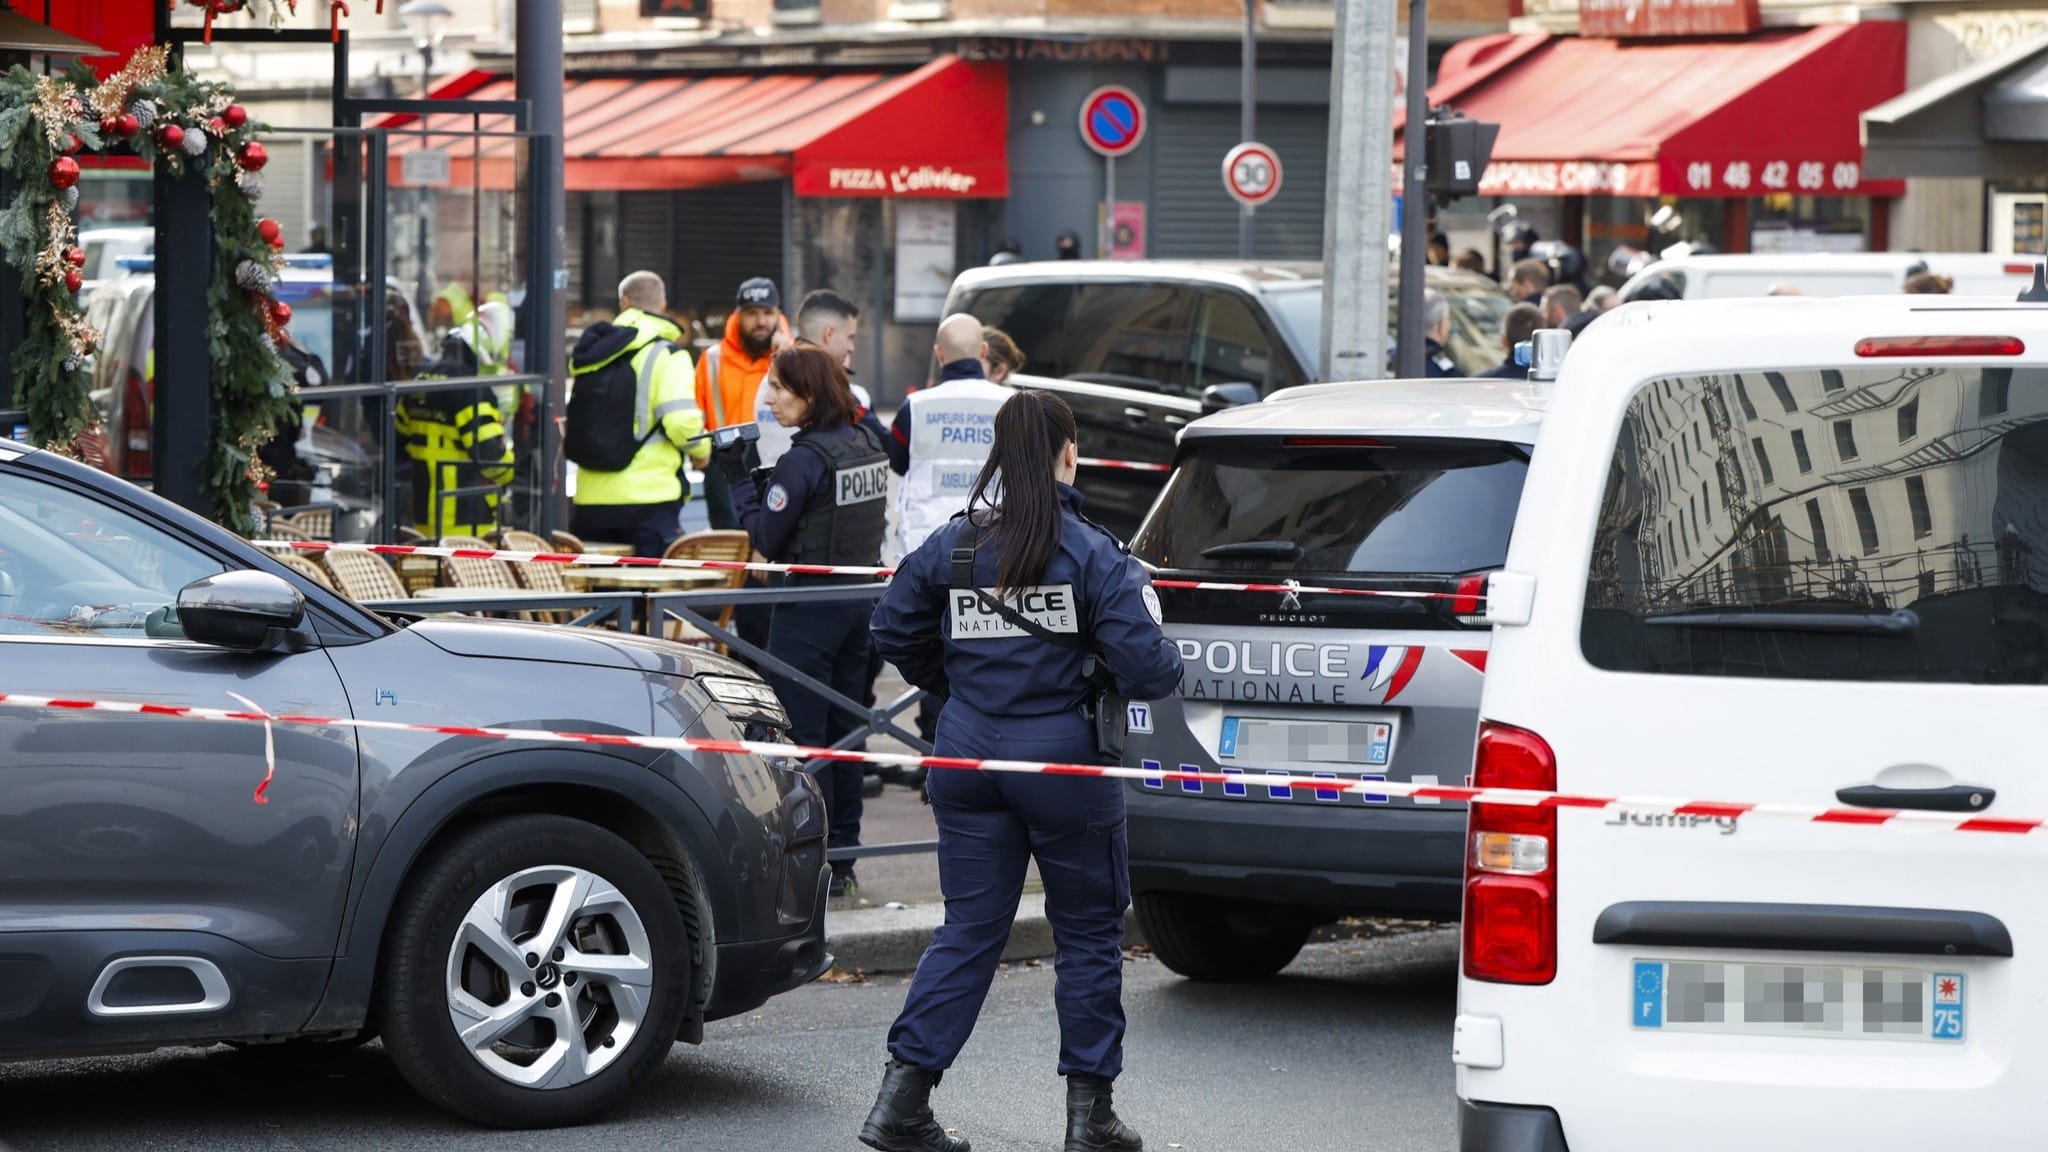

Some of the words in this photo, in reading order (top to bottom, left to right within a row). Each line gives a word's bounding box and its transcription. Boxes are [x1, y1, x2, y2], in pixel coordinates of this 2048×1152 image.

[829, 167, 887, 190] PIZZA
[1237, 162, 1270, 187] 30
[1687, 161, 1712, 190] 01
[1723, 161, 1750, 190] 46
[1761, 160, 1789, 189] 42
[1797, 161, 1824, 190] 05
[1832, 161, 1860, 190] 00
[926, 412, 965, 425] SAPEURS
[966, 413, 995, 425] POMPI
[941, 426, 993, 445] PARIS
[940, 471, 990, 489] AMBULA
[957, 591, 1066, 616] POICE
[959, 615, 1069, 632] NATIOALE
[1259, 614, 1327, 623] PEUGEOT
[1175, 638, 1350, 679] POLICE
[1173, 679, 1346, 705] NATIONALE
[1129, 706, 1147, 728] 17
[1372, 745, 1386, 760] 75
[1643, 1001, 1654, 1018] F
[1934, 1009, 1961, 1035] 75
